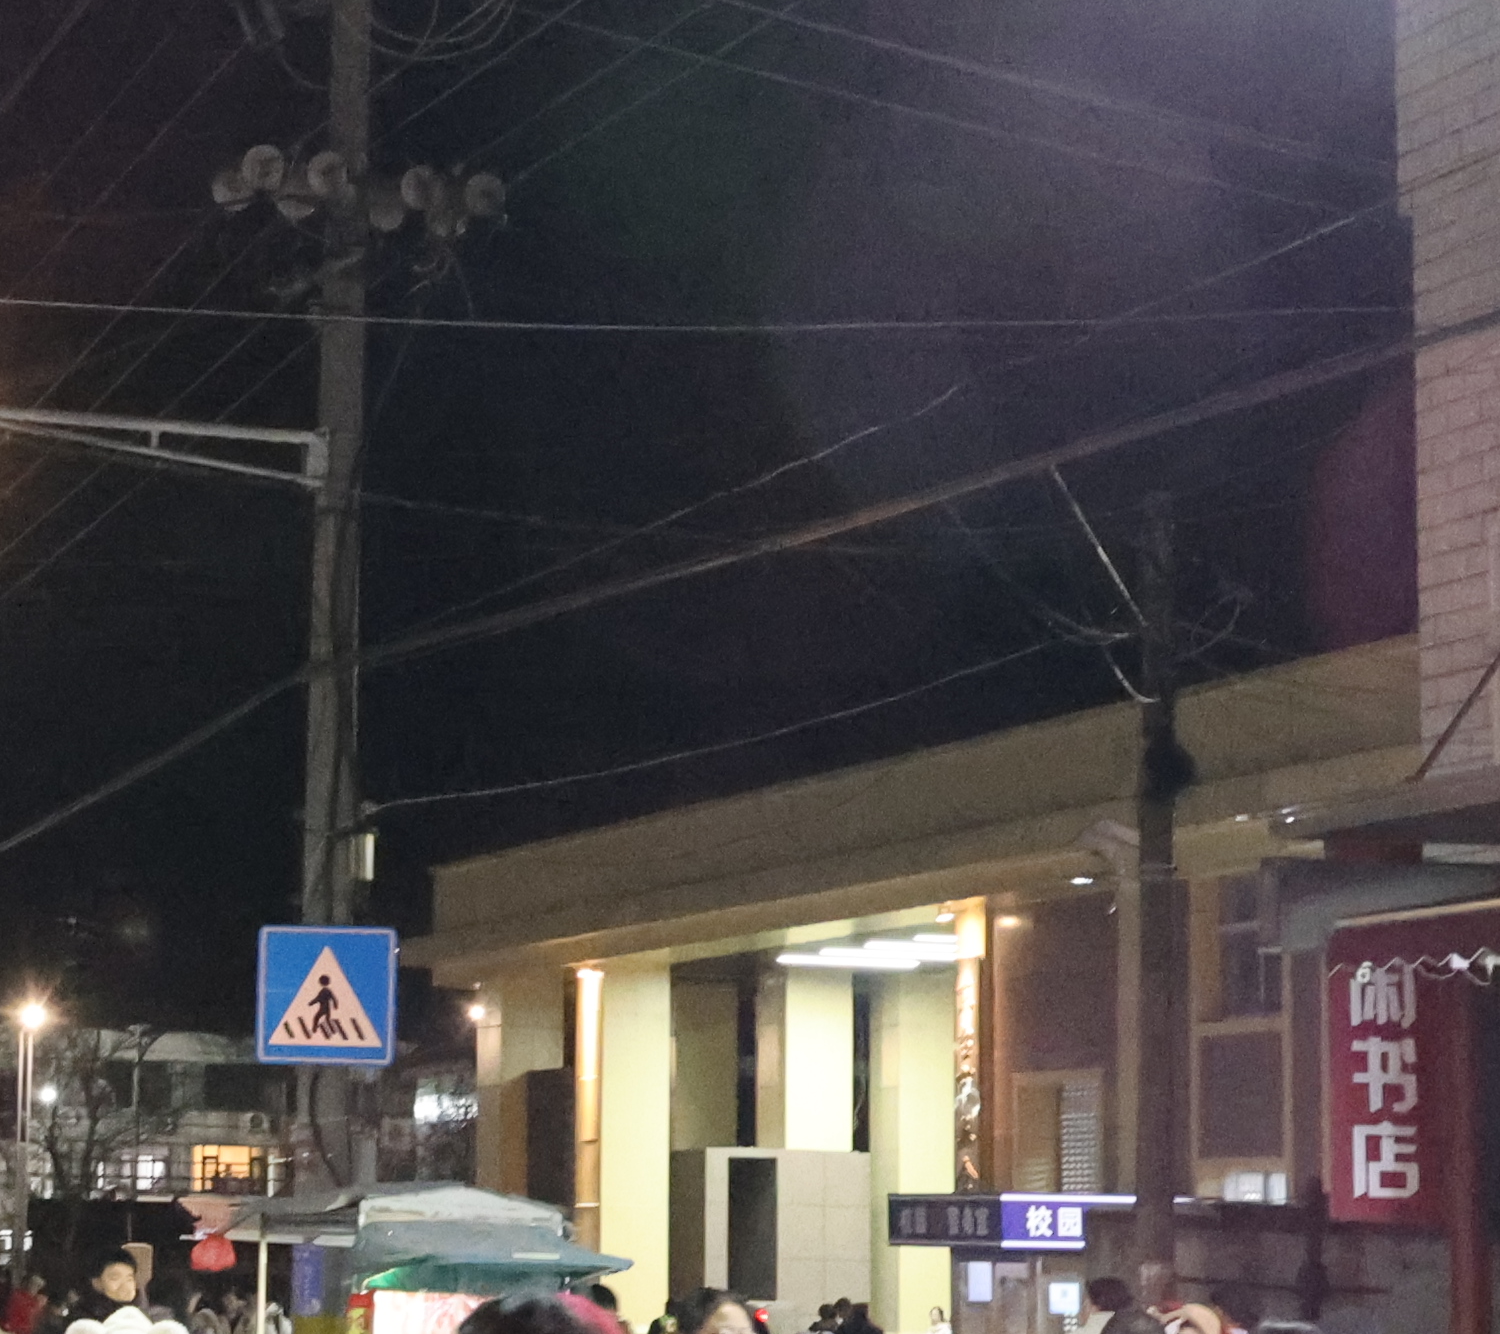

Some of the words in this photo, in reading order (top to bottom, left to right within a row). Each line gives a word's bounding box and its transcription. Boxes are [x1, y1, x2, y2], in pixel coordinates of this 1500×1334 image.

[1350, 964, 1420, 1199] 闲书店
[1025, 1204, 1083, 1238] 校园
